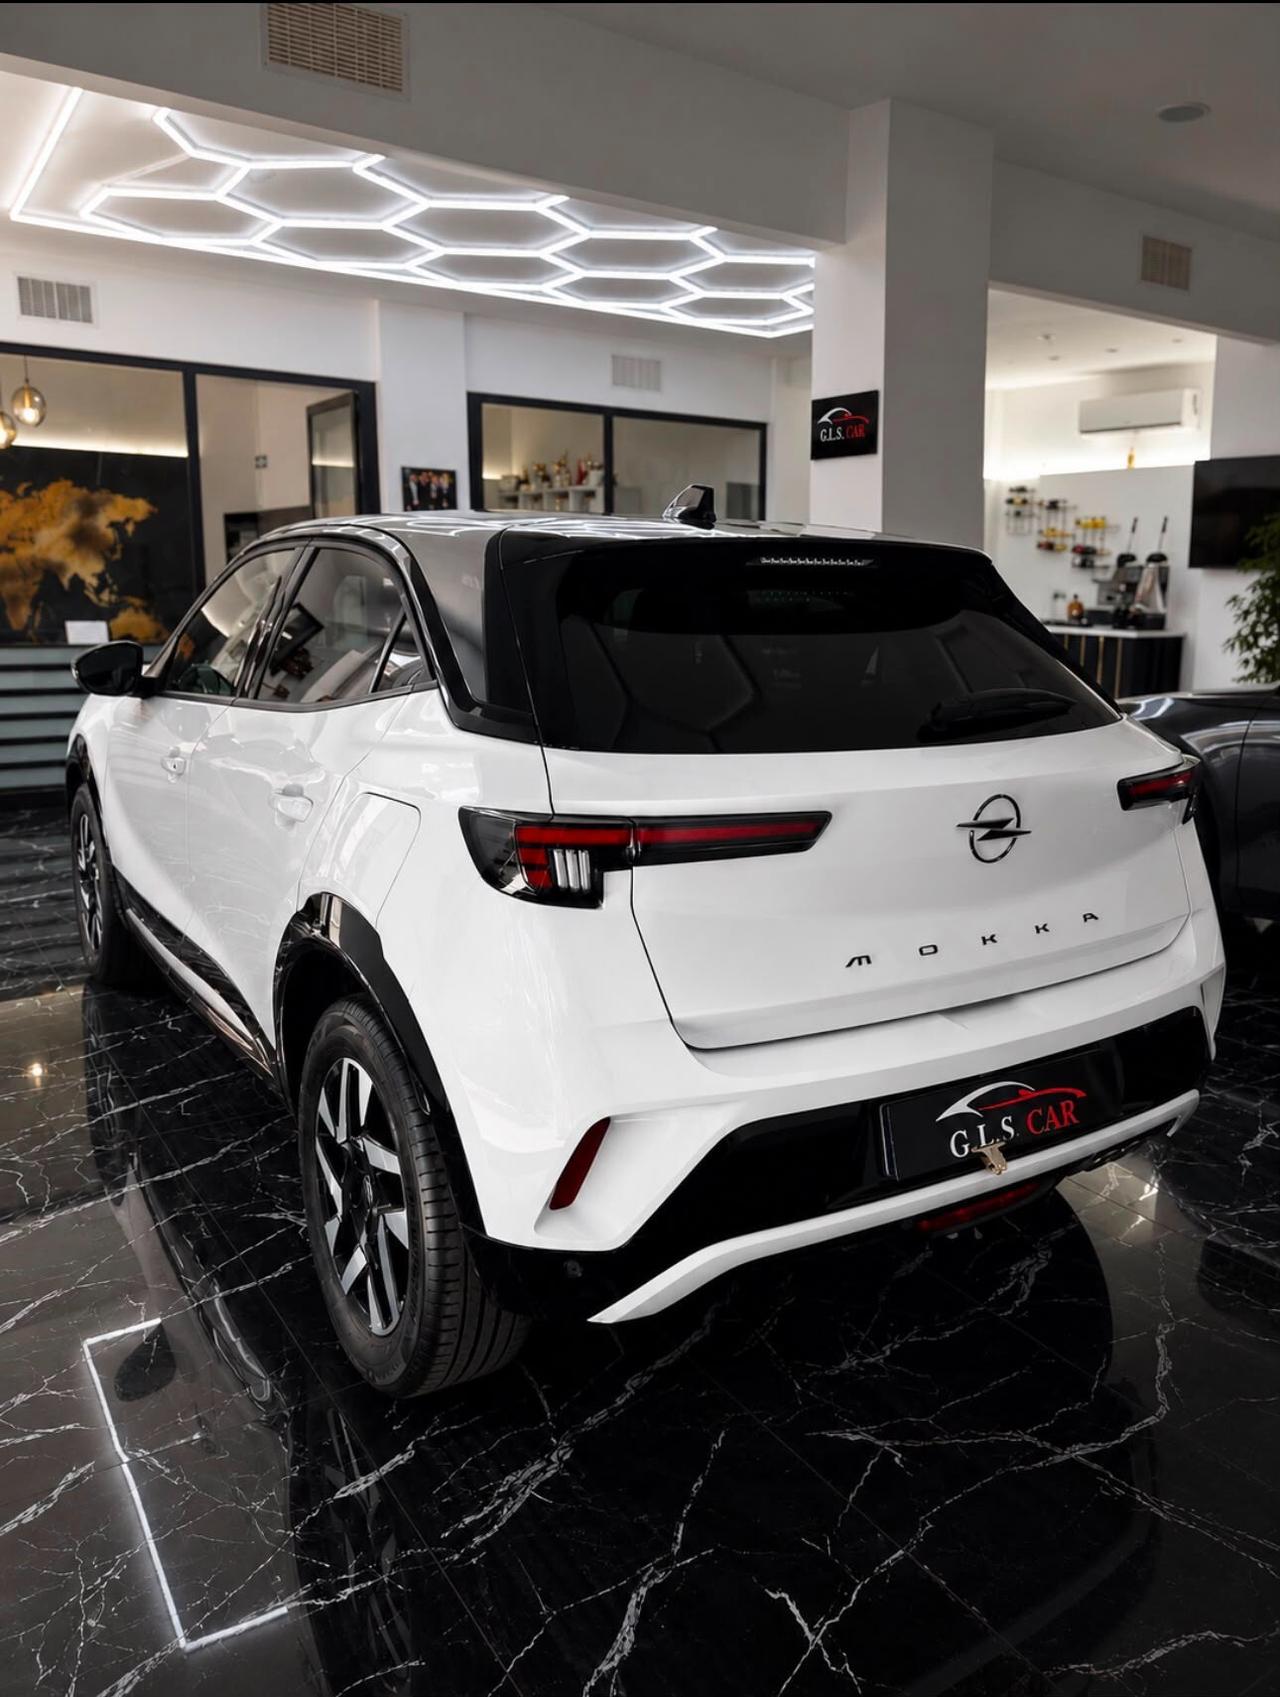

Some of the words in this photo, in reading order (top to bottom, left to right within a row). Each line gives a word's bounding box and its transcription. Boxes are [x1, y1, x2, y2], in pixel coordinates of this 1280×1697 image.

[846, 424, 865, 439] CAR
[845, 912, 1099, 968] MOKKA
[1026, 1100, 1080, 1135] CAR
